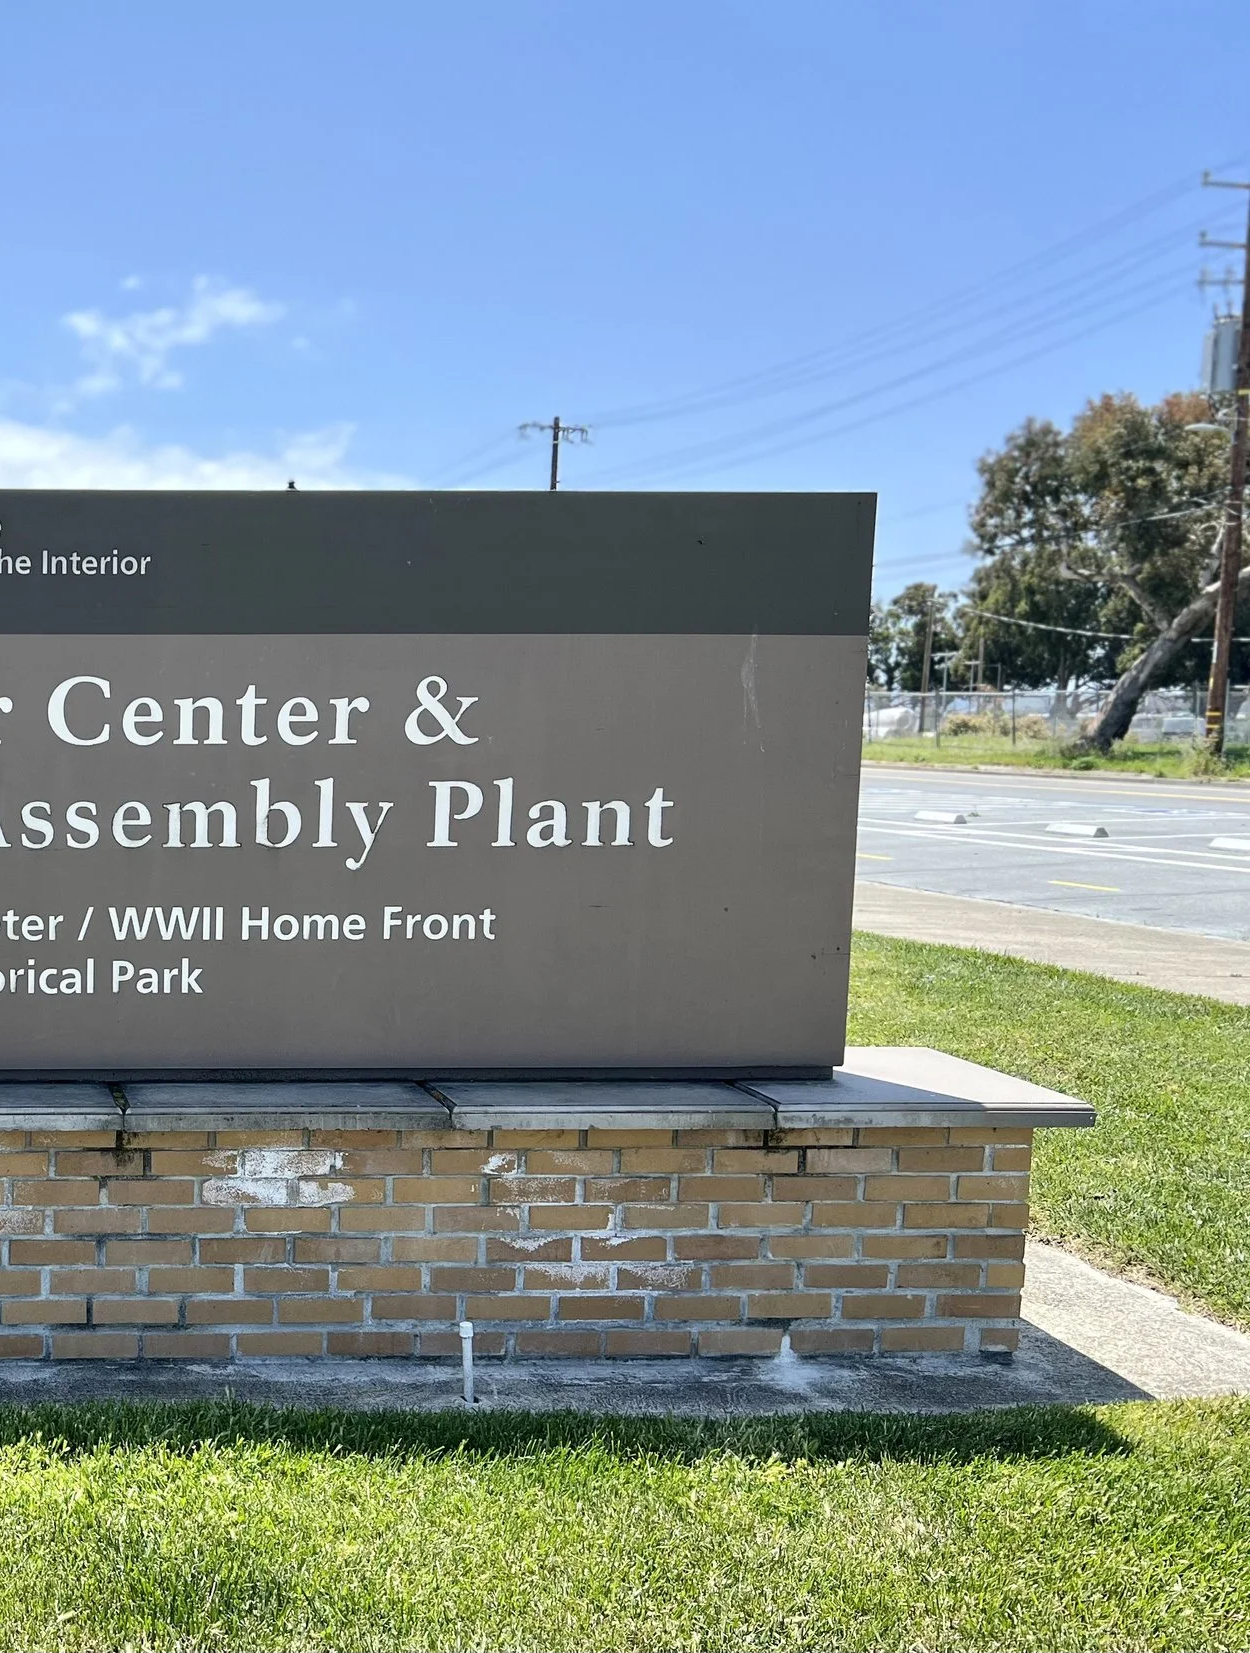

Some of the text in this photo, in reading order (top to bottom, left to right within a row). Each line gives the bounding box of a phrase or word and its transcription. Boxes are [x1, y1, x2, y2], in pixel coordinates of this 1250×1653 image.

[42, 549, 151, 576] Interior
[47, 675, 370, 746] Center
[404, 675, 480, 746] &
[426, 776, 674, 848] Plant
[77, 906, 95, 942] /
[107, 906, 224, 941] WWII
[241, 906, 367, 941] Home
[383, 906, 497, 940] Front
[112, 957, 203, 994] Park
